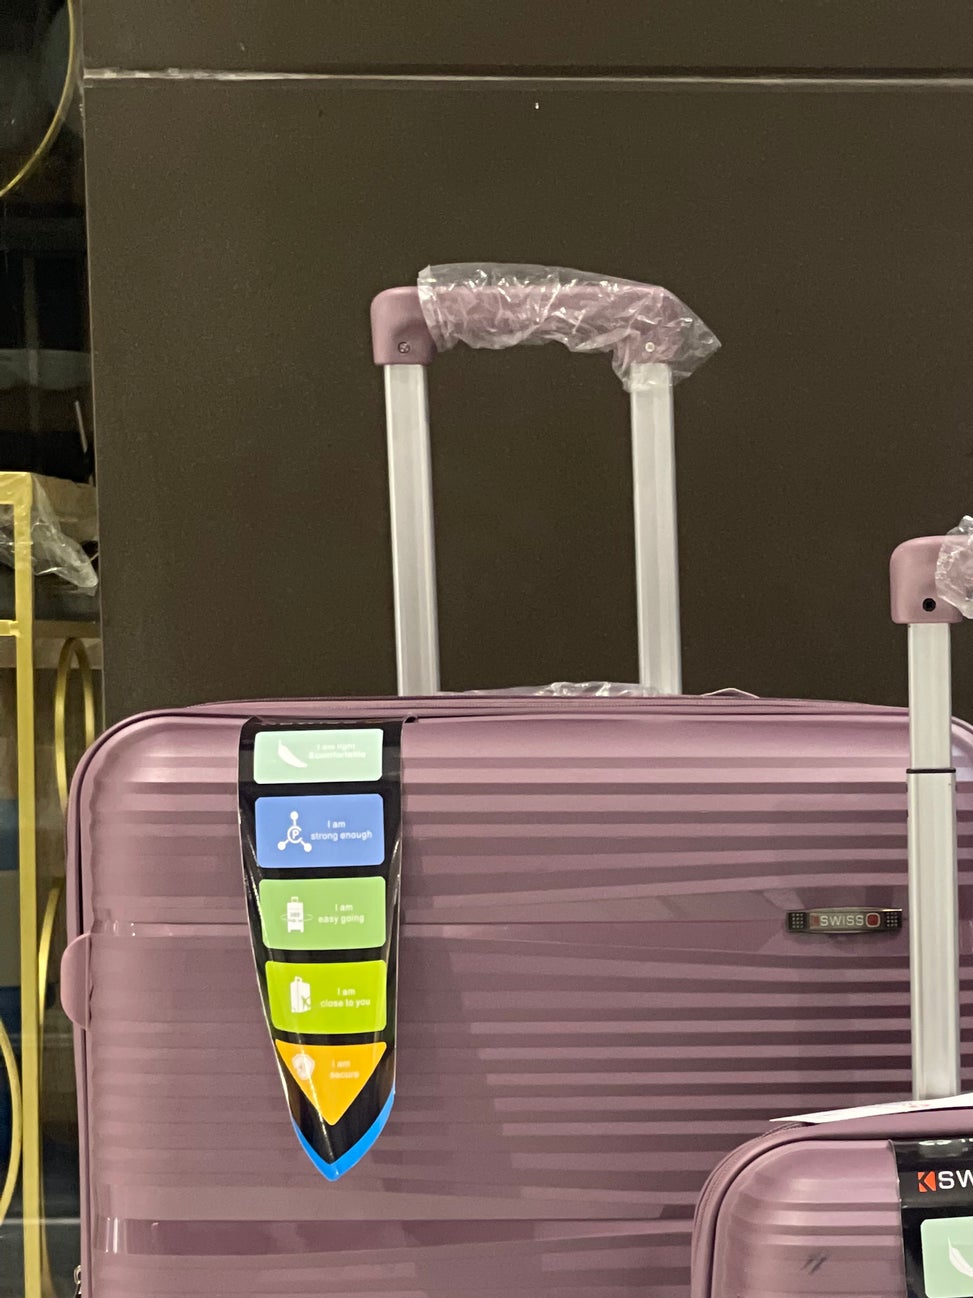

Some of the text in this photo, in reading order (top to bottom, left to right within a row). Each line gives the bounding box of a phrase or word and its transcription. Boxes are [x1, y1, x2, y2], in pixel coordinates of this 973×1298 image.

[327, 820, 346, 829] I am
[311, 830, 373, 842] strong enough
[339, 904, 354, 912] am
[318, 913, 365, 925] easy going
[320, 998, 371, 1008] close to you
[337, 1060, 351, 1068] am
[329, 1070, 360, 1080] secure
